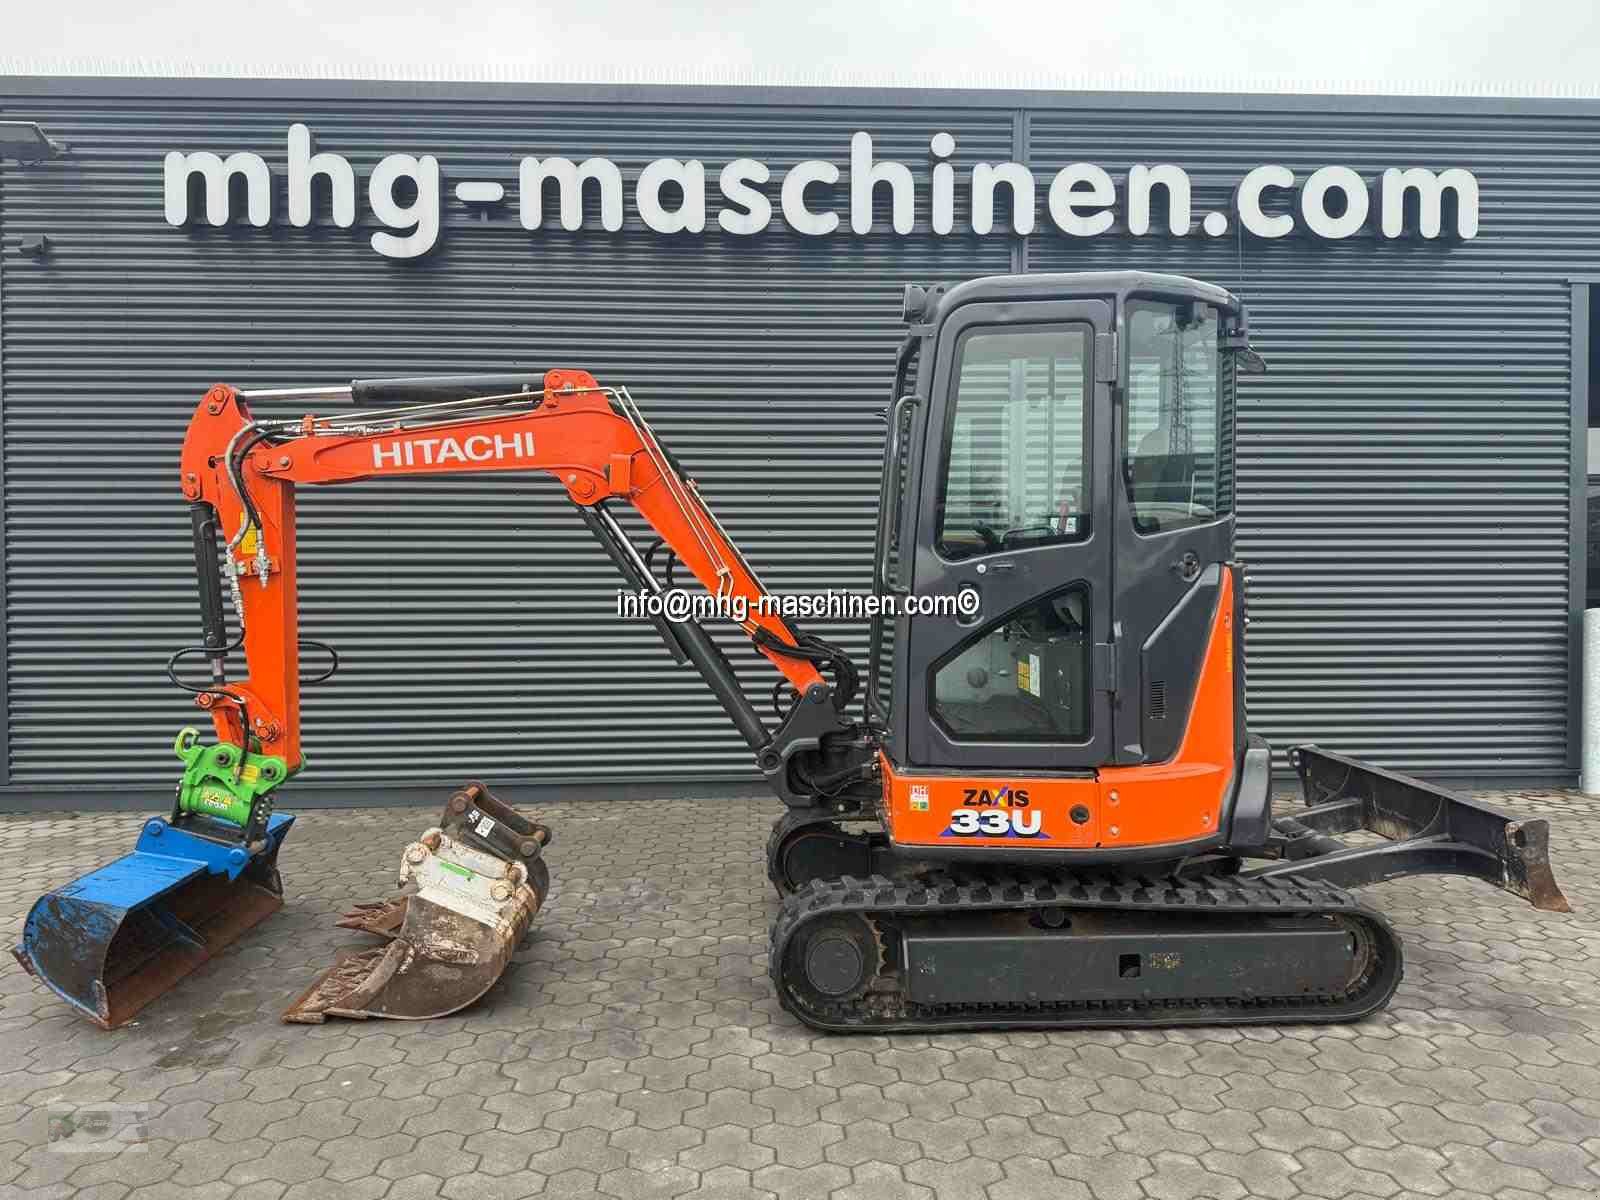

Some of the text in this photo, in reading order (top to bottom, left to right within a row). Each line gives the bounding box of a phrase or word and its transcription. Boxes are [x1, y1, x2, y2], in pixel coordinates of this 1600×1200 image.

[164, 123, 1479, 258] mhg-maschinen.com
[372, 431, 535, 468] HITACHI
[963, 785, 1029, 808] ZAXIS
[950, 809, 1042, 838] 33U
